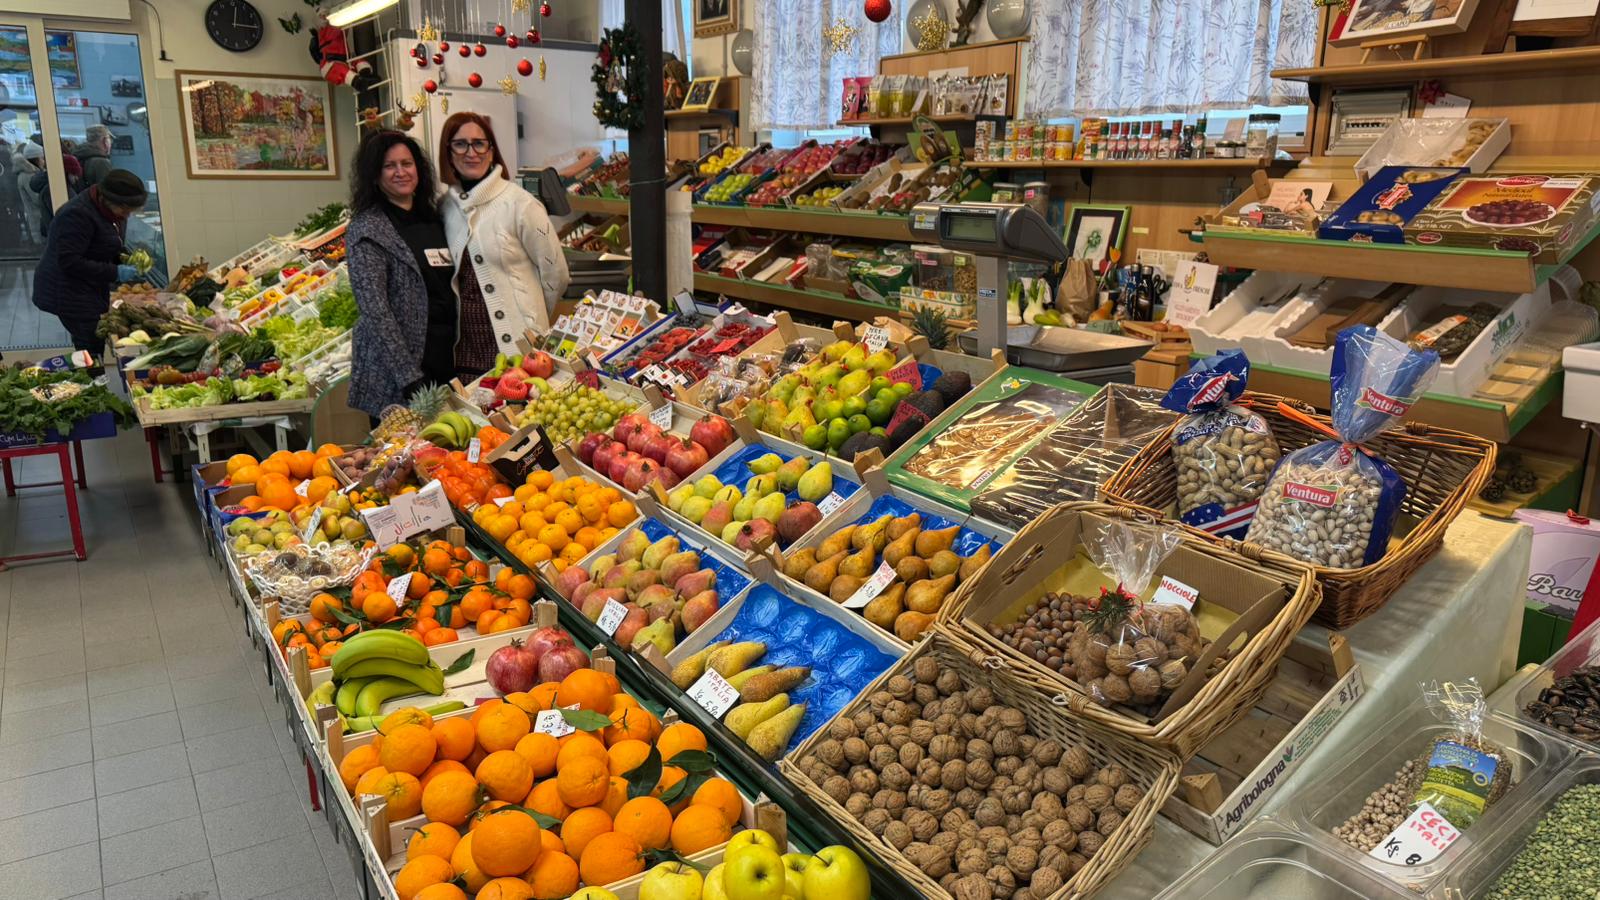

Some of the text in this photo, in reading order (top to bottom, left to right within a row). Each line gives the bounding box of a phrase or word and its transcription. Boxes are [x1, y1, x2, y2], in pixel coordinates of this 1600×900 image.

[1367, 388, 1404, 414] Ventura
[1286, 484, 1334, 503] Ventura
[1161, 580, 1197, 603] NOCCIOLE
[1526, 573, 1584, 602] Bau
[707, 671, 733, 695] ABATE
[708, 680, 729, 704] ITALIA
[1225, 760, 1286, 828] Agribologna
[1420, 811, 1457, 842] CECI
[1405, 853, 1422, 865] 8
